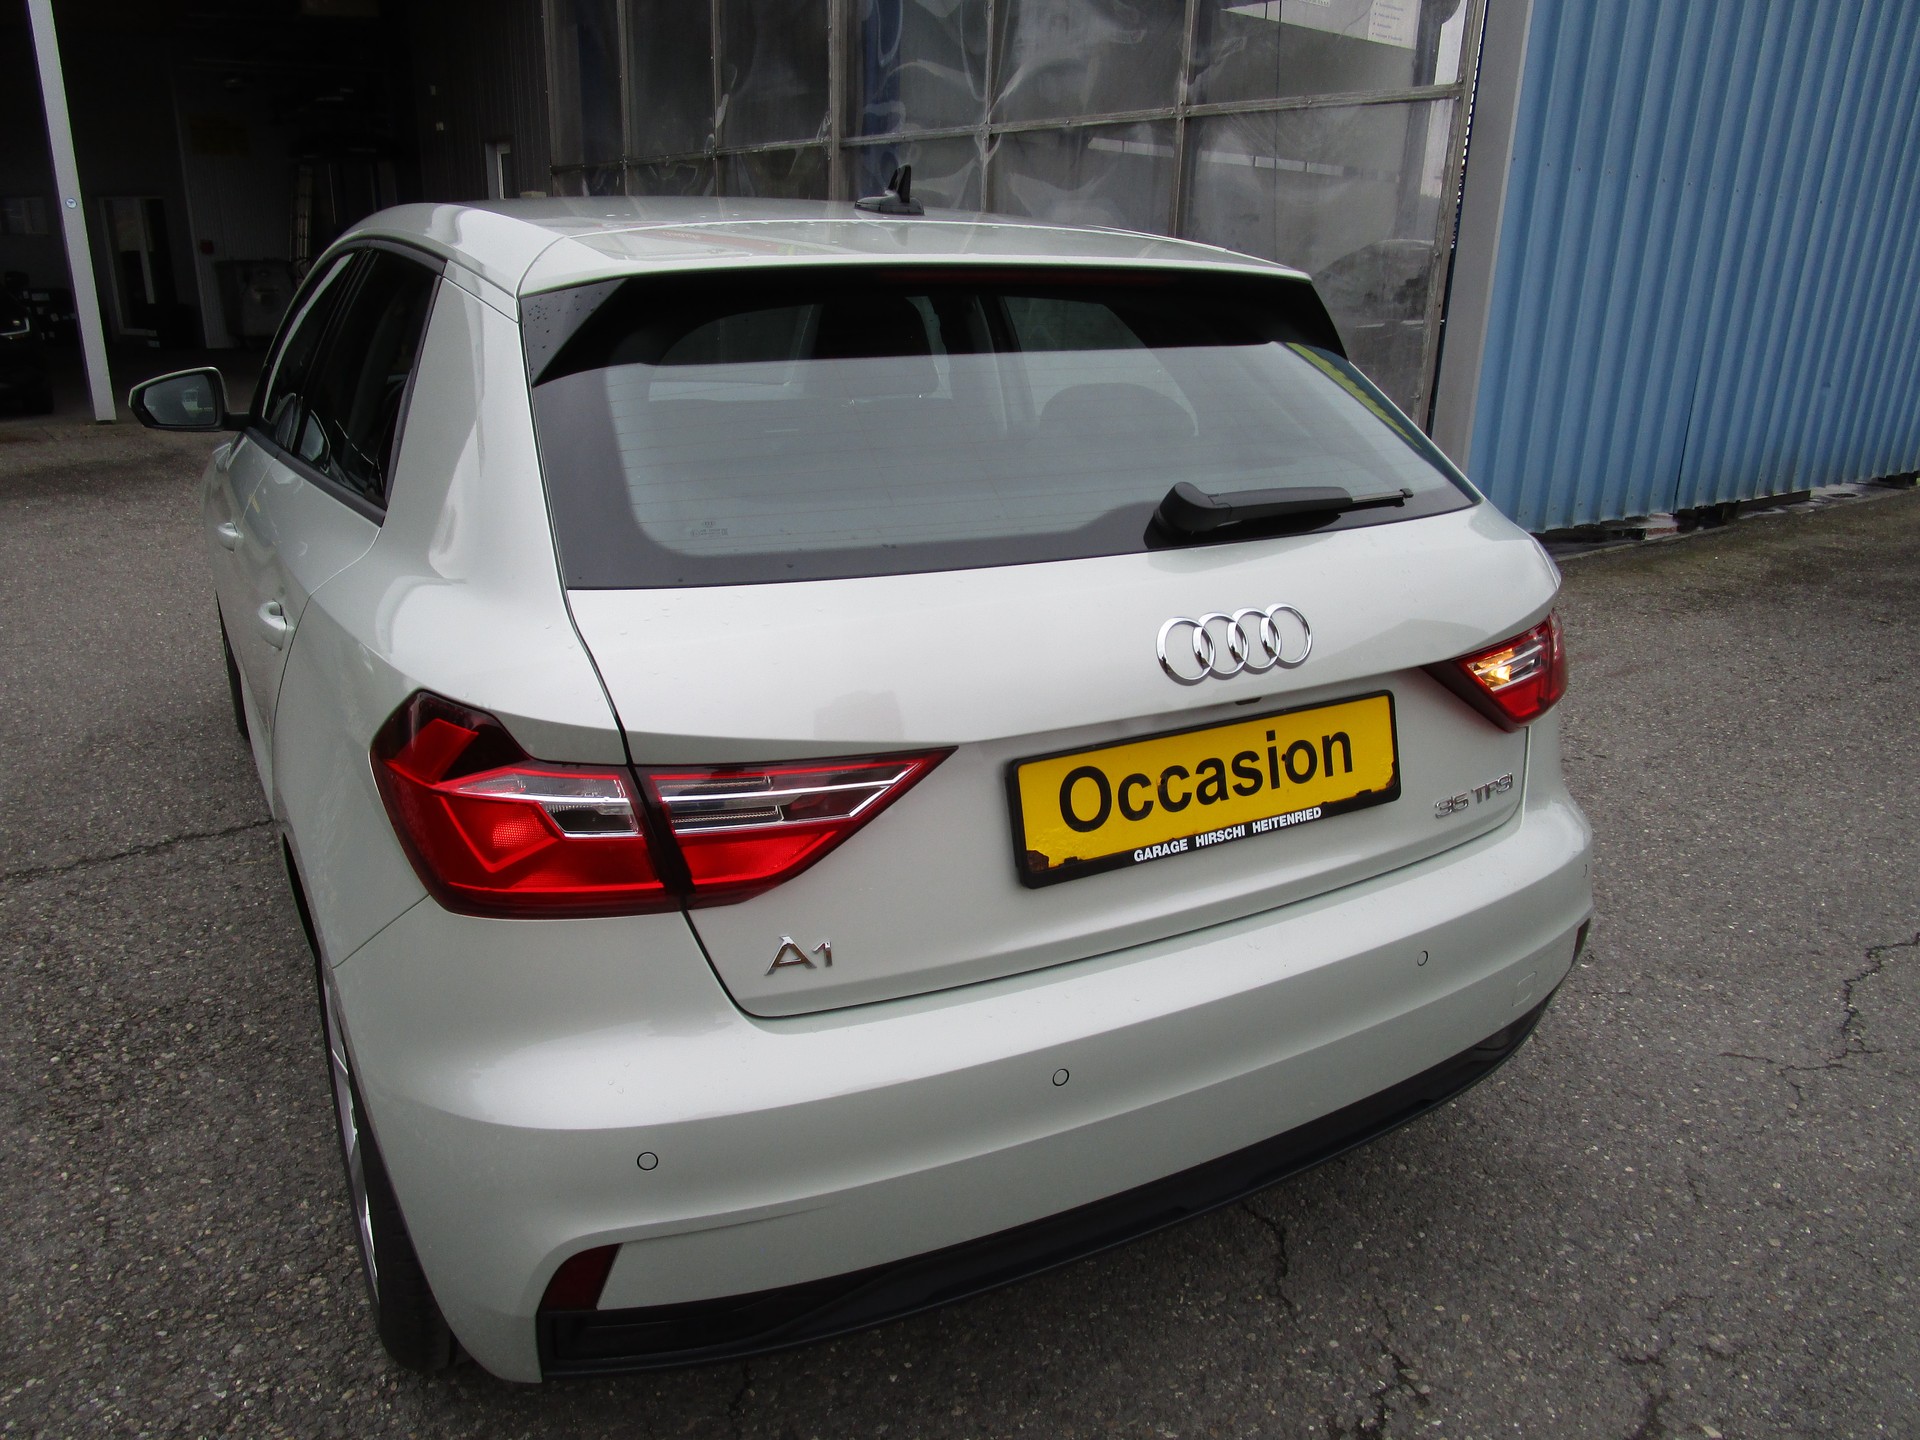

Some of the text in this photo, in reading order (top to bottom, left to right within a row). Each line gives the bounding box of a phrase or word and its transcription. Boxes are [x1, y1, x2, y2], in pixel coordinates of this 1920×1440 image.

[1059, 730, 1353, 832] Occasion
[1434, 772, 1513, 819] 35 TFSI
[1133, 806, 1322, 863] GARAGE HIRSCHI HEITENRIED
[764, 935, 833, 976] A1
